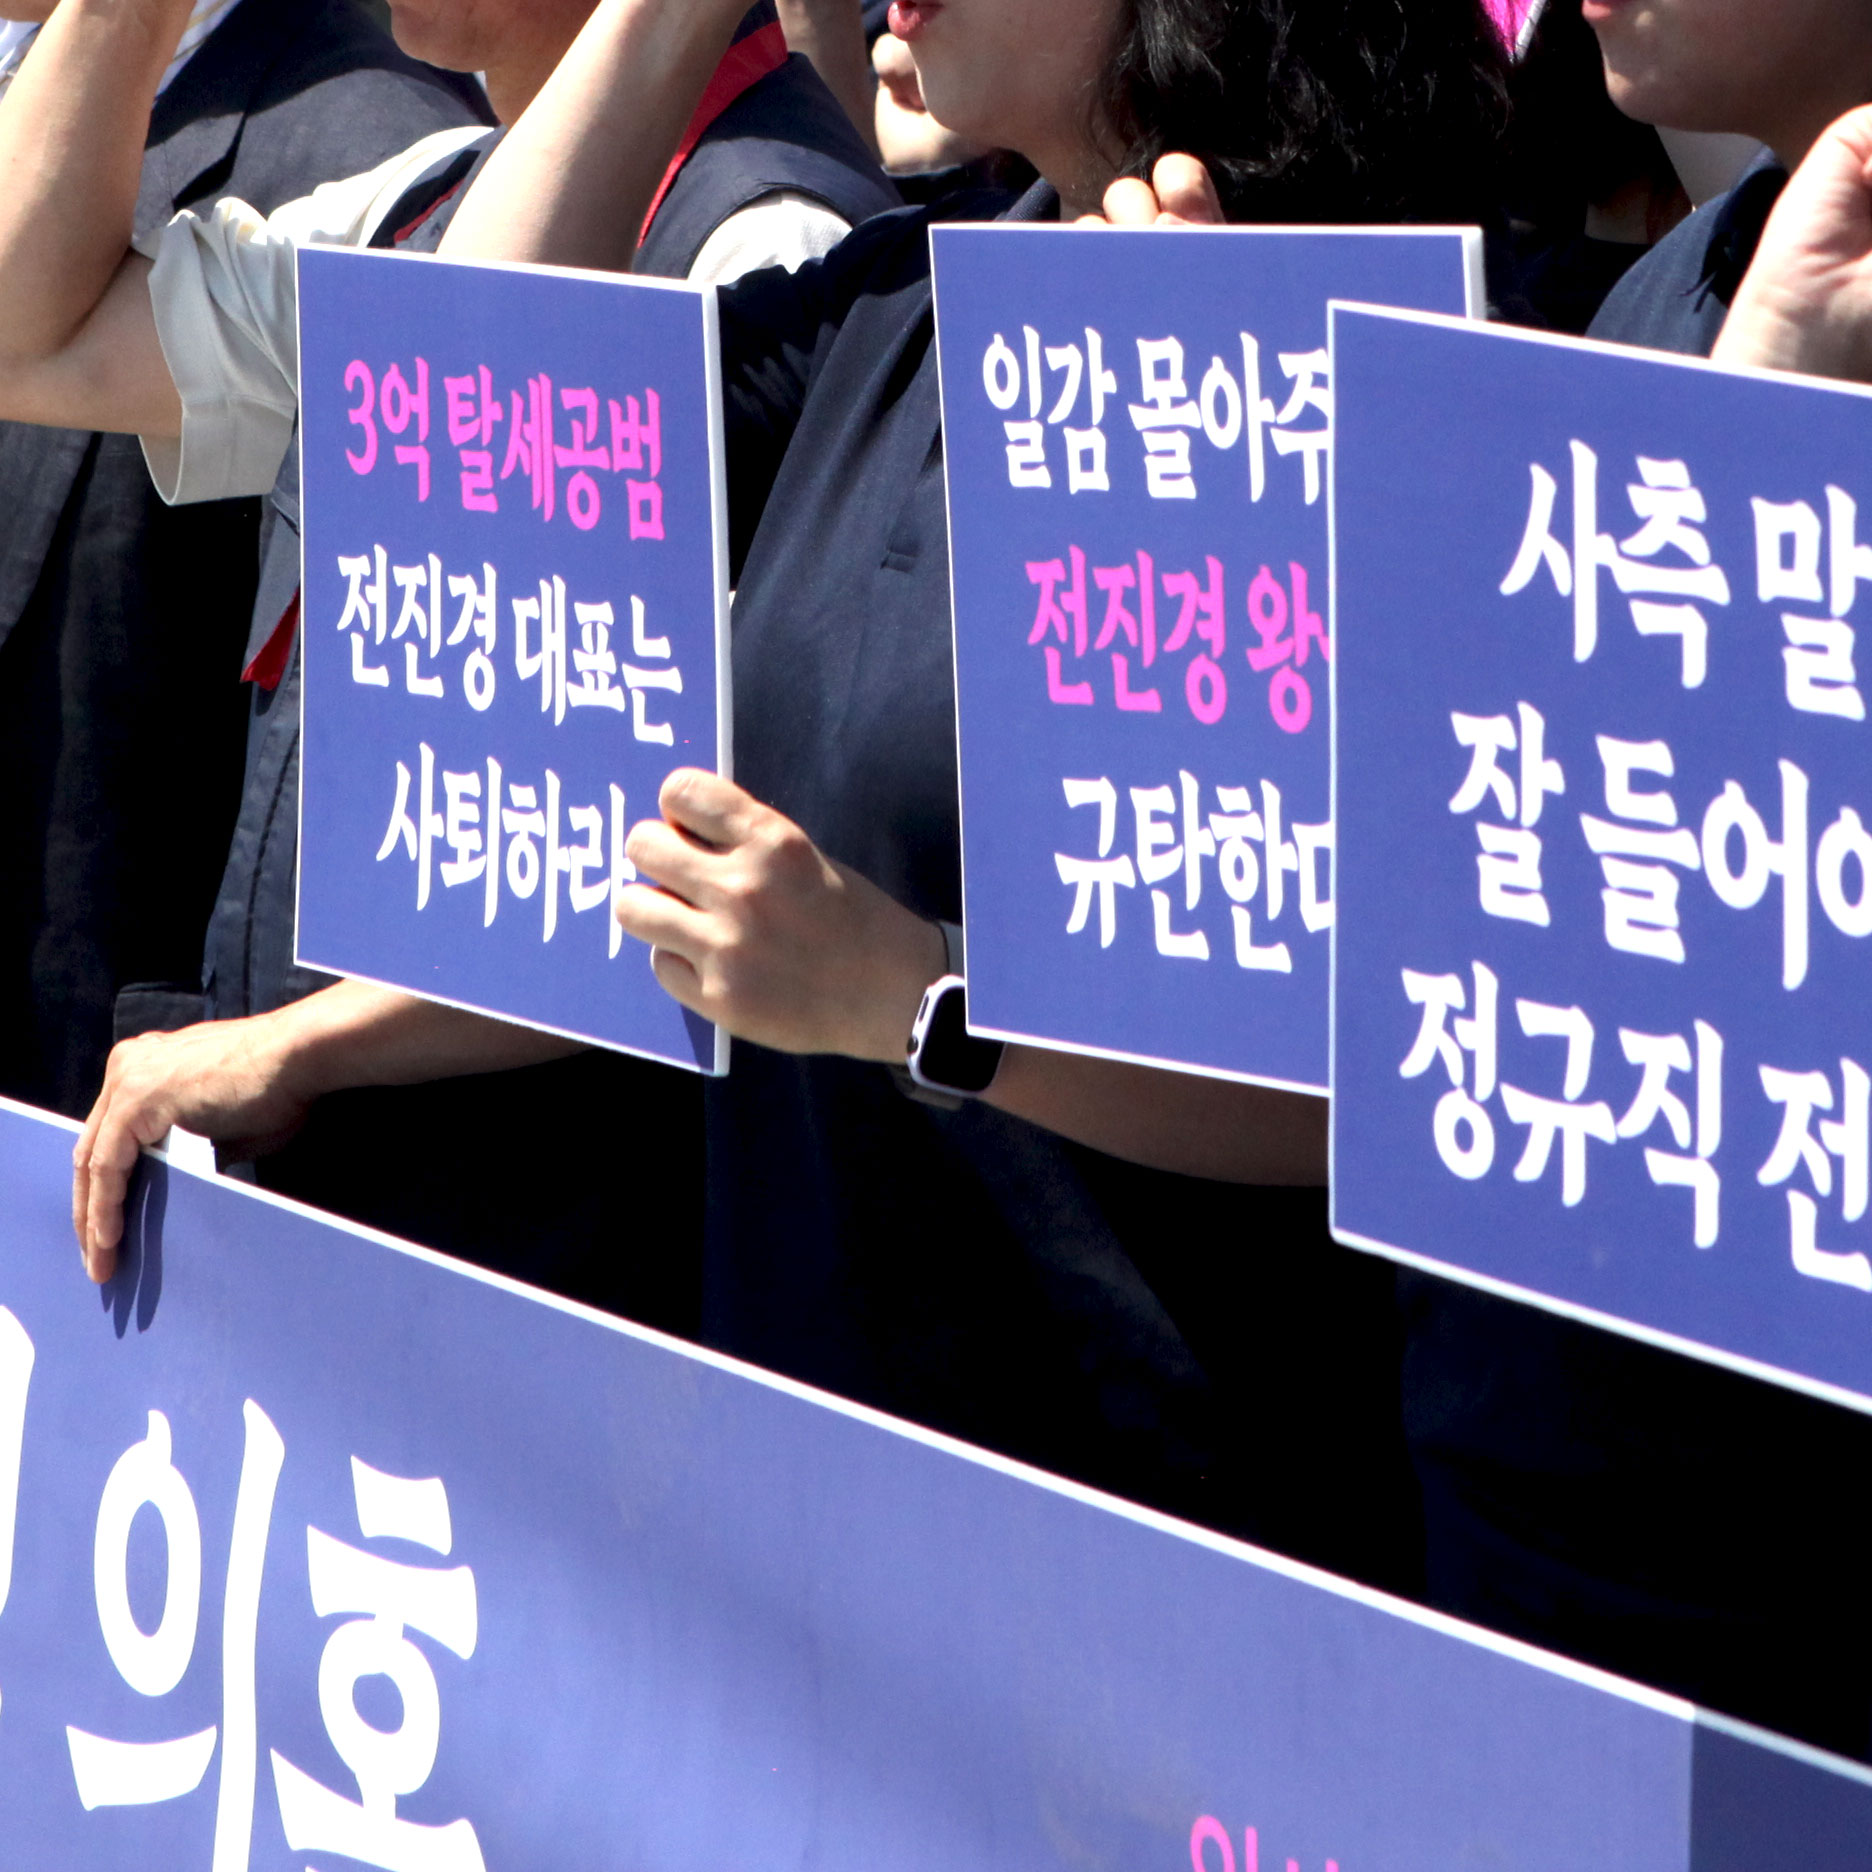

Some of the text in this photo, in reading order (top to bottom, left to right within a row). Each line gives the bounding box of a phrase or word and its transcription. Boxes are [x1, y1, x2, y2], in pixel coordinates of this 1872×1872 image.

[343, 356, 665, 541] 3억 탈세공범
[982, 325, 1118, 495] 일감
[336, 543, 683, 747] 전진경 대표는
[1024, 544, 1229, 726] 전진경
[1500, 438, 1730, 689] 사측
[376, 741, 636, 960] 사퇴하라
[1448, 700, 1566, 928] 잘
[1398, 959, 1726, 1251] 정규직
[65, 1397, 487, 1872] 의혹
